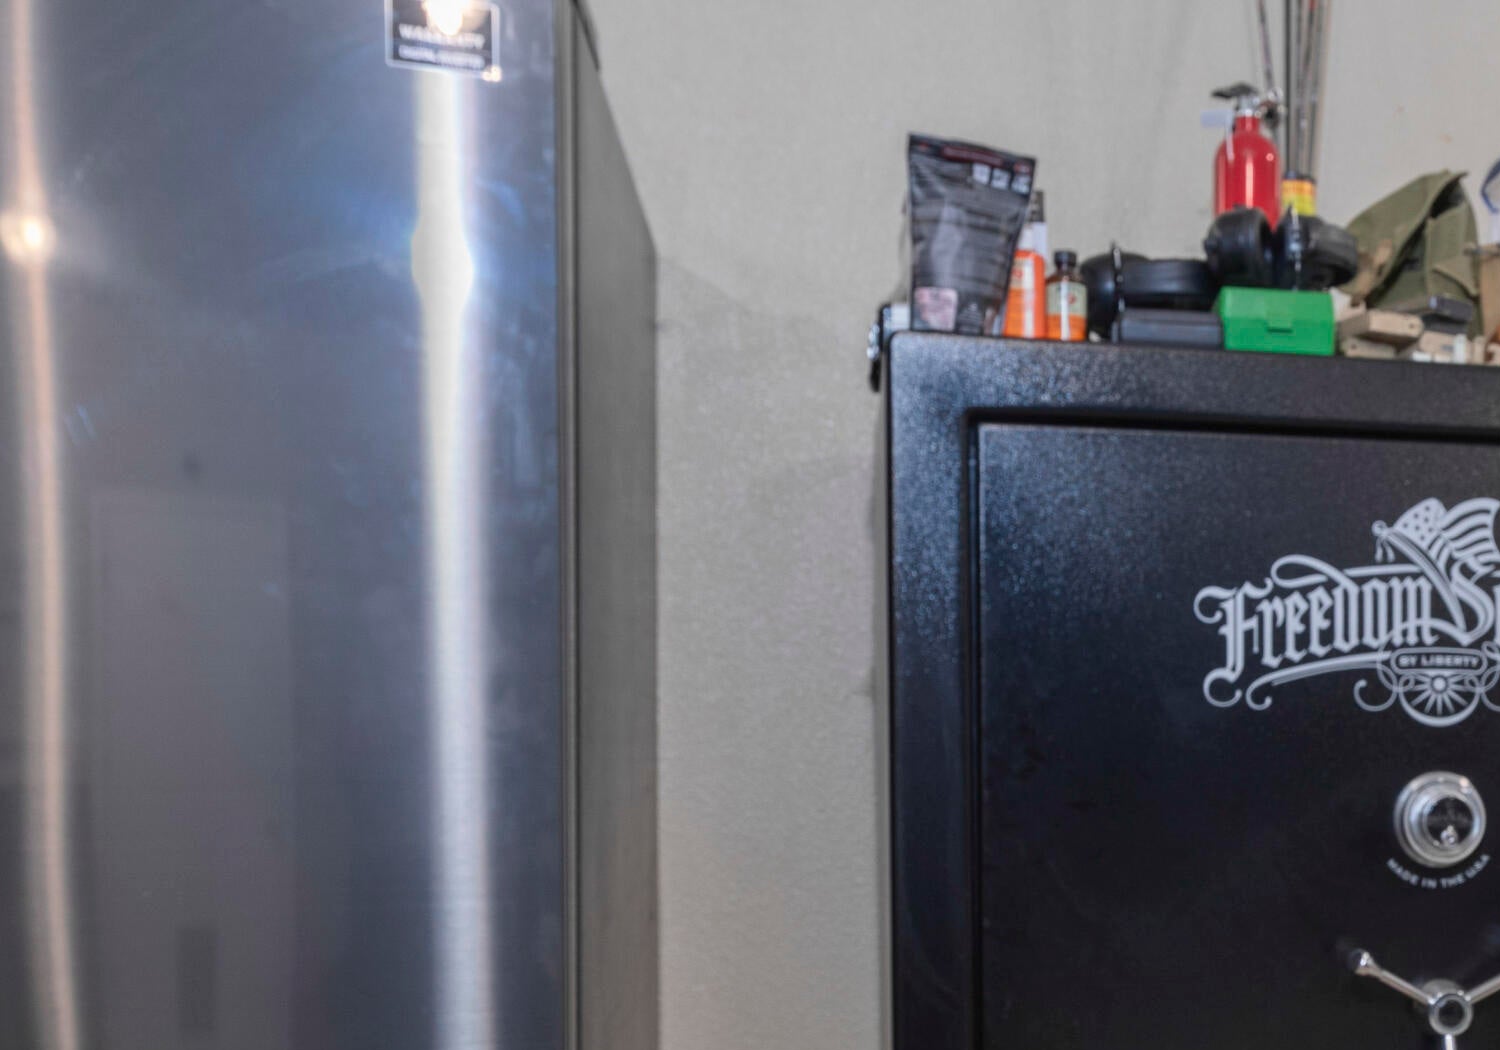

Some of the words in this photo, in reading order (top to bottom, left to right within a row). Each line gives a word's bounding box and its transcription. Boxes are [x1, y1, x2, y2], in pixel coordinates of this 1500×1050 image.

[1194, 555, 1438, 708] Freedom
[1420, 654, 1480, 668] LIBERTY
[1386, 858, 1419, 886] MADE
[1420, 877, 1438, 889] IN
[1440, 873, 1465, 889] THE
